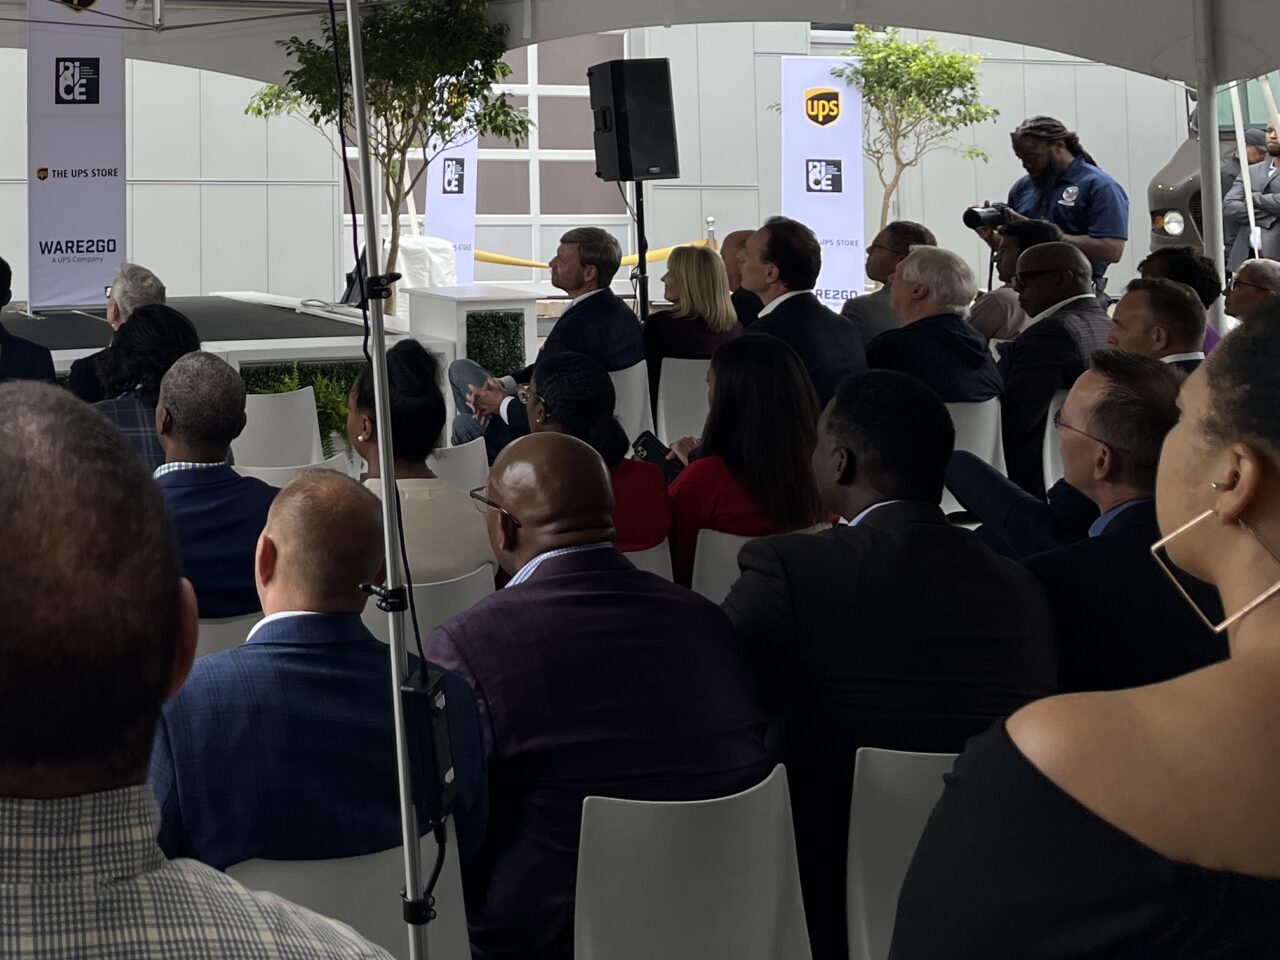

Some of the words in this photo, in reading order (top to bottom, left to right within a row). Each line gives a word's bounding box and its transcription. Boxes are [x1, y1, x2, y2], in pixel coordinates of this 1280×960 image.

[807, 100, 838, 121] ups
[51, 169, 68, 179] THE
[71, 168, 89, 178] UPS
[91, 168, 119, 178] STORE
[39, 239, 117, 255] WARE2GO
[57, 256, 72, 264] UPS
[72, 255, 104, 264] Company
[815, 289, 858, 300] RE2GO
